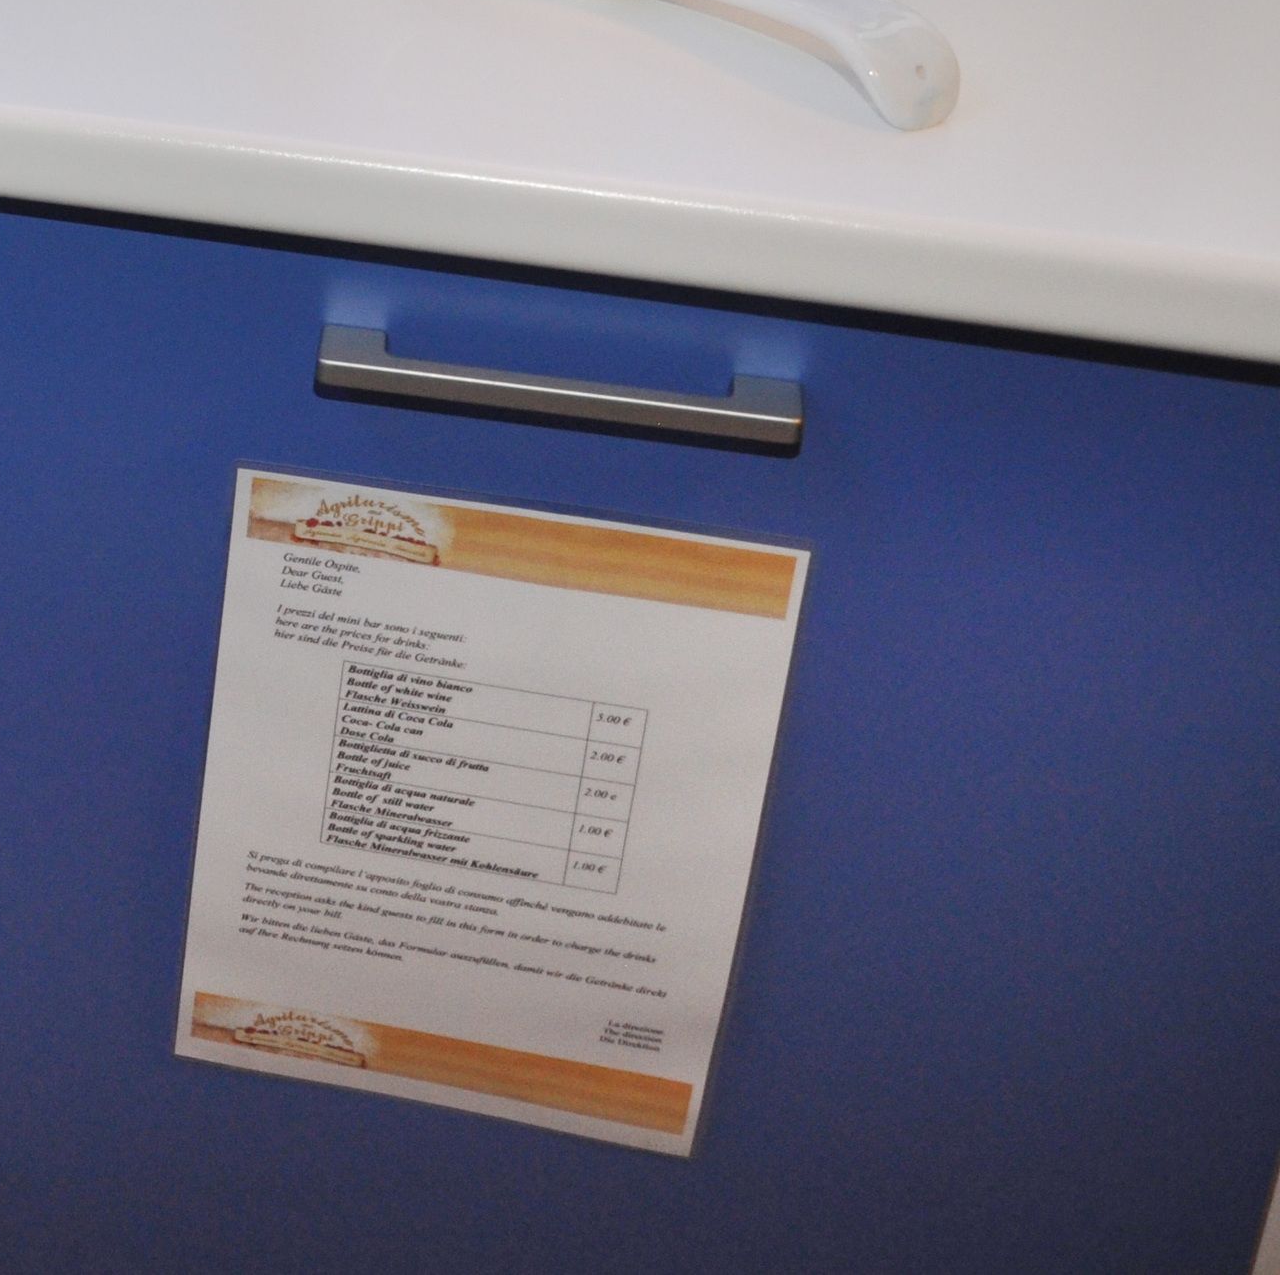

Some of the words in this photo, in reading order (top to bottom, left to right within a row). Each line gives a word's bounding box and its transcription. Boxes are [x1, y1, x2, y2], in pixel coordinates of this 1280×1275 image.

[282, 565, 309, 577] Dear
[283, 552, 323, 567] Gentile
[280, 578, 310, 591] Liebe
[312, 583, 343, 597] Gäste
[275, 616, 299, 628] here
[301, 623, 320, 632] are
[322, 624, 338, 635] the
[339, 629, 373, 641] prices
[373, 633, 391, 644] for
[277, 604, 284, 613] I
[283, 607, 317, 619] prezzi
[318, 611, 336, 622] del
[337, 616, 362, 626] mini
[363, 617, 383, 629] bar
[384, 624, 411, 634] sono
[274, 628, 296, 640] hier
[297, 634, 322, 645] sind
[322, 637, 339, 648] die
[341, 640, 375, 654] Preise
[375, 647, 394, 657] für
[395, 649, 413, 660] die
[415, 653, 468, 669] Getränke:
[346, 677, 378, 690] Bottle
[380, 684, 395, 694] of
[396, 687, 425, 698] white
[427, 692, 453, 703] wine
[348, 664, 395, 680] Bottiglia
[396, 673, 409, 683] di
[411, 676, 434, 687] vino
[436, 679, 474, 694] bianco
[345, 689, 388, 704] Flasche
[391, 697, 447, 713] Weisswein
[343, 702, 382, 717] Lattina
[384, 710, 396, 719] di
[398, 712, 426, 724] Coca
[428, 717, 454, 729] Cola
[376, 721, 402, 733] Cola
[404, 727, 424, 736] can
[623, 717, 632, 726] €
[340, 726, 367, 738] Dose
[370, 732, 395, 744] Cola
[337, 750, 369, 763] Bottle
[371, 758, 385, 767] of
[383, 759, 412, 771] juice
[338, 738, 397, 756] Bottiglietta
[399, 749, 411, 759] di
[413, 753, 444, 764] succo
[445, 757, 458, 767] di
[456, 760, 490, 773] frutta
[590, 751, 615, 762] 2.00
[616, 755, 626, 764] €
[336, 762, 392, 780] Fruchtsaft
[332, 787, 364, 800] Bottle
[366, 794, 380, 804] of
[383, 797, 404, 807] still
[406, 802, 436, 812] water
[334, 775, 379, 790] Bottiglia
[381, 784, 394, 793] di
[394, 788, 428, 799] acqua
[430, 793, 476, 807] naturale
[584, 787, 608, 799] 2.00
[331, 799, 373, 814] Flasche
[377, 807, 454, 828] Mineralwasser
[328, 823, 358, 835] Bottle
[361, 830, 375, 839] of
[375, 833, 425, 849] sparkling
[428, 843, 457, 853] water
[329, 811, 374, 827] Bottiglia
[376, 820, 388, 829] di
[389, 825, 422, 835] acqua
[423, 828, 472, 844] frizzante
[578, 824, 602, 835] 1.00
[604, 828, 613, 838] €
[326, 834, 367, 848] Flasche
[371, 842, 449, 862] Mineralwasser
[450, 858, 469, 867] mit
[470, 859, 540, 877] Kohlensäure
[573, 861, 596, 872] 1.00
[598, 865, 606, 874] €
[246, 863, 289, 878] bevande
[290, 871, 354, 890] direttamente
[370, 887, 400, 898] conto
[400, 891, 428, 903] della
[259, 854, 291, 866] prega
[292, 858, 303, 868] di
[305, 862, 357, 877] compilare
[412, 879, 443, 892] foglio
[444, 885, 457, 895] di
[457, 889, 505, 903] consumo
[551, 906, 596, 919] vengano
[597, 914, 655, 930] addebitate
[656, 922, 668, 933] le
[242, 894, 282, 909] directly
[297, 906, 322, 915] your
[245, 882, 264, 893] The
[265, 887, 313, 902] reception
[314, 897, 337, 906] asks
[339, 900, 356, 910] the
[357, 902, 382, 914] kind
[380, 909, 414, 920] guests
[416, 915, 428, 923] to
[427, 916, 445, 926] fill
[446, 919, 458, 928] in
[459, 921, 478, 932] this
[478, 925, 506, 937] form
[507, 931, 520, 939] in
[520, 934, 551, 944] order
[552, 939, 564, 948] to
[564, 941, 603, 955] charge
[604, 948, 622, 958] the
[622, 951, 657, 964] drinks
[238, 927, 258, 936] auf
[281, 932, 331, 950] Rechnung
[332, 944, 364, 954] setzen
[242, 913, 260, 923] Wir
[262, 917, 291, 929] bitten
[292, 922, 309, 932] die
[399, 941, 449, 957] Formular
[513, 963, 545, 975] damit
[546, 970, 564, 978] wir
[565, 973, 584, 982] die
[585, 976, 634, 992] Getränke
[636, 986, 668, 999] direkt
